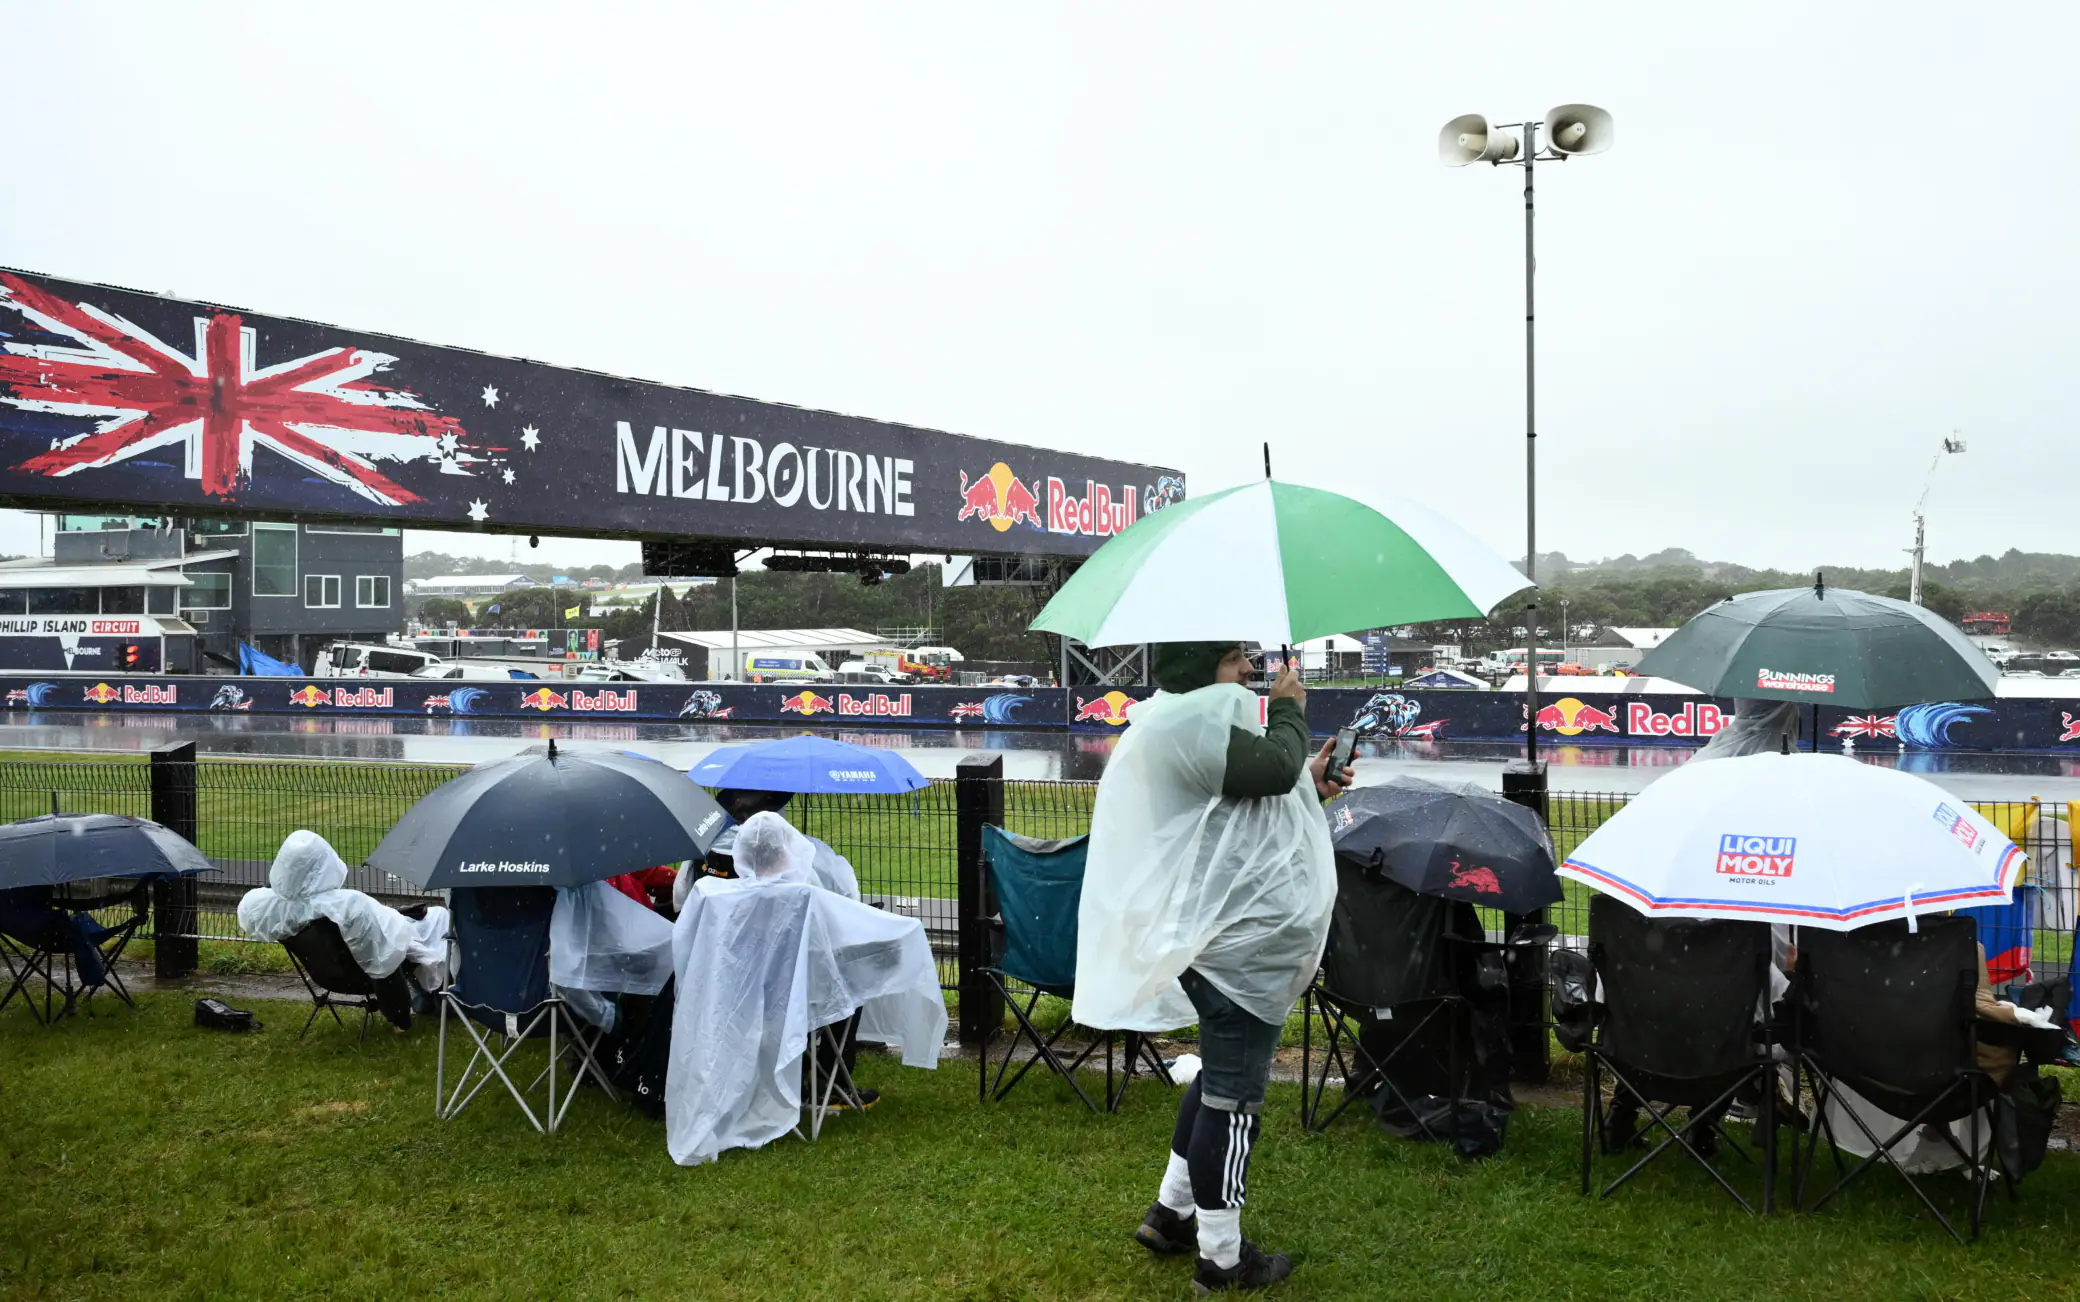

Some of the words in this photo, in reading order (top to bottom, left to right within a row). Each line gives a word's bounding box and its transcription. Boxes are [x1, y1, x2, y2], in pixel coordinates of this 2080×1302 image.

[615, 421, 914, 517] MELBOURNE
[1048, 476, 1094, 535] Red
[1096, 483, 1136, 536] Bull
[0, 620, 38, 633] HILLIP
[43, 620, 87, 633] ISLAND
[93, 621, 138, 632] CIRCUIT
[1759, 668, 1834, 684] BUNNINGS
[1763, 680, 1829, 692] warehouse
[124, 685, 151, 703] Red
[151, 685, 176, 703] Bull
[336, 687, 364, 707] Red
[365, 687, 393, 707] Bull
[572, 690, 605, 711] Red
[605, 690, 637, 711] Bull
[838, 693, 875, 715] Red
[876, 693, 911, 716] Bull
[1628, 702, 1694, 736] Red
[839, 770, 876, 779] YAMAHA
[1723, 835, 1793, 855] LIQUI
[460, 861, 496, 873] Larke
[498, 861, 550, 873] Hoskins
[1719, 854, 1792, 875] MOLY
[1729, 877, 1756, 885] MOTOR
[1758, 878, 1776, 886] OILS
